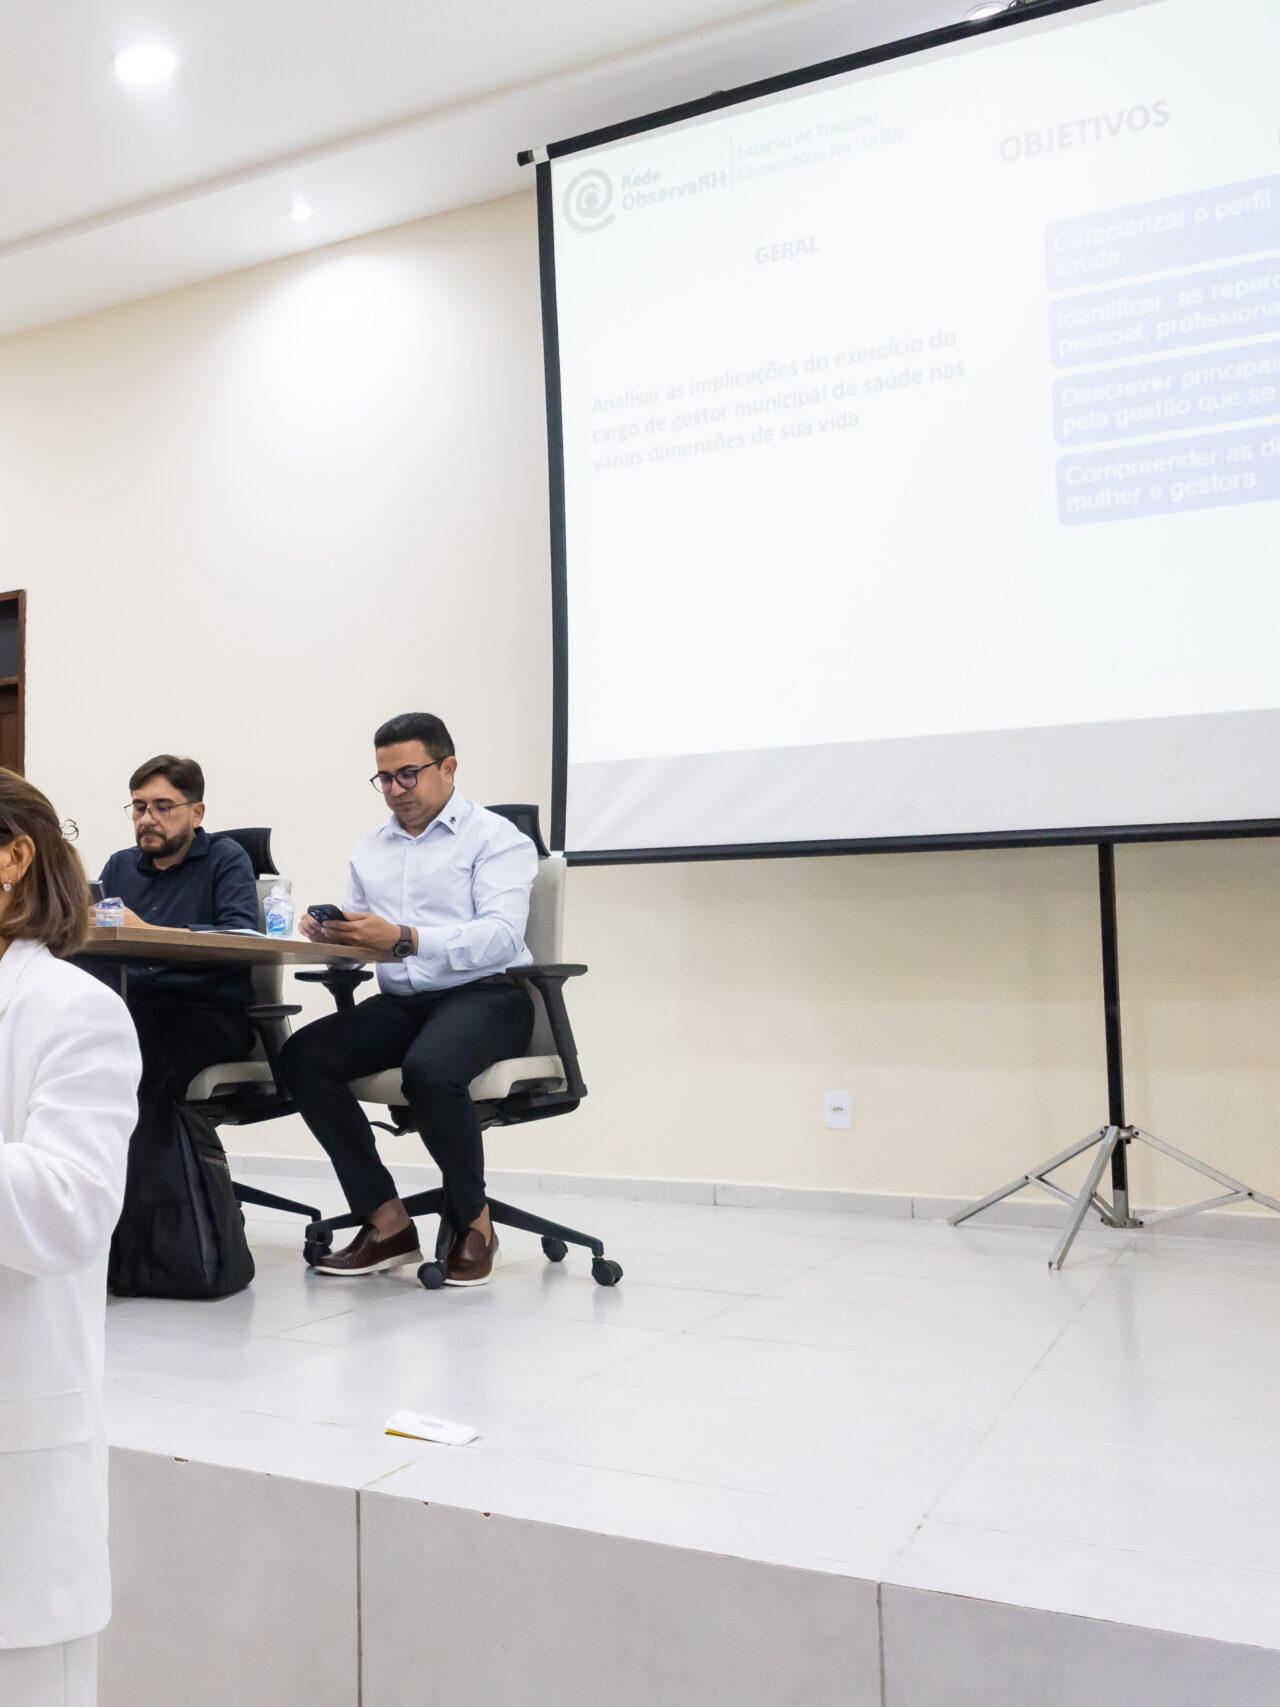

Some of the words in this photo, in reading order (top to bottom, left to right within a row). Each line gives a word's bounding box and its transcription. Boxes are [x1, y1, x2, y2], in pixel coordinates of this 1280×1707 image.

[998, 99, 1170, 164] OBJETIVOS
[621, 169, 661, 191] Rede
[622, 170, 727, 211] ObservaRH
[1054, 210, 1185, 251] Caracterizar
[1194, 208, 1209, 223] o
[1215, 189, 1271, 222] perfil
[754, 235, 820, 265] GERAL
[1057, 296, 1163, 329] Identificar
[1178, 289, 1204, 307] as
[1059, 322, 1150, 359] pessoal,
[1157, 301, 1280, 341] profissiona
[591, 389, 660, 415] Analisar
[666, 380, 684, 400] as
[689, 359, 799, 396] implicações
[804, 355, 829, 375] do
[834, 336, 923, 368] exercício
[929, 328, 957, 350] do
[1062, 373, 1175, 407] Descrever
[592, 424, 640, 444] cargo
[644, 415, 667, 435] de
[671, 405, 728, 433] gestor
[735, 385, 826, 419] municipal
[832, 380, 857, 400] de
[863, 366, 923, 395] saúde
[929, 361, 966, 383] nas
[1063, 410, 1108, 437] pela
[1115, 398, 1191, 429] gestão
[1198, 391, 1241, 415] que
[1248, 386, 1275, 403] se
[592, 450, 644, 472] várias
[648, 432, 745, 464] dimensões
[751, 426, 774, 445] de
[779, 420, 812, 440] sua
[818, 410, 859, 433] vida
[1065, 448, 1217, 485] Compreender
[1226, 445, 1254, 463] as
[1066, 486, 1142, 512] mulher
[1149, 485, 1163, 500] e
[1170, 471, 1263, 502] gestora.
